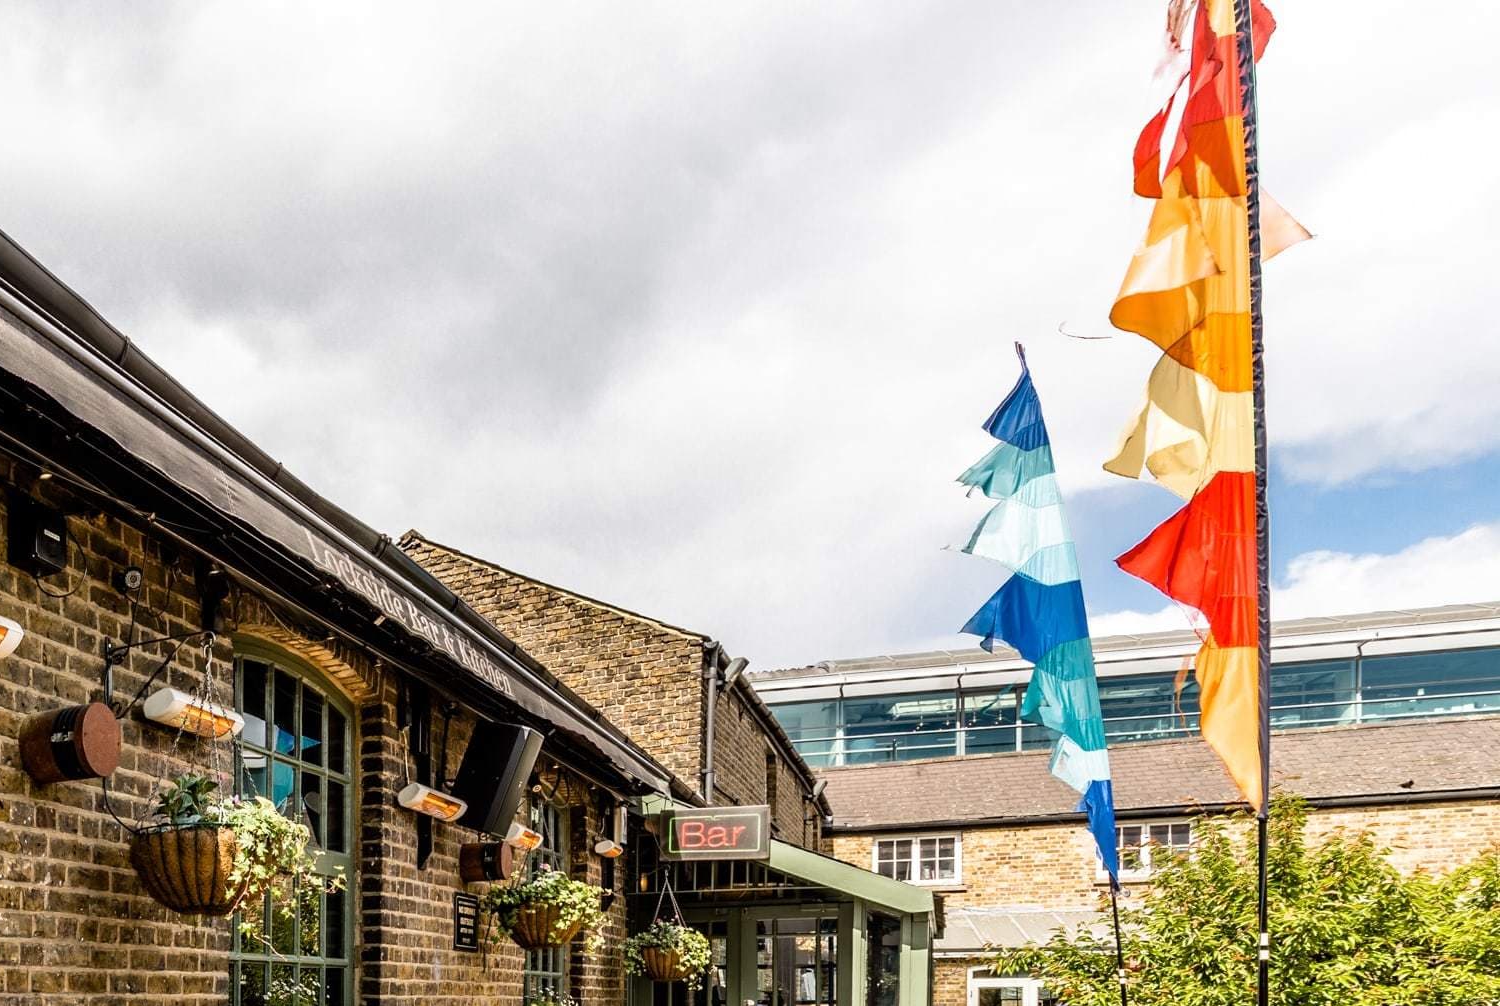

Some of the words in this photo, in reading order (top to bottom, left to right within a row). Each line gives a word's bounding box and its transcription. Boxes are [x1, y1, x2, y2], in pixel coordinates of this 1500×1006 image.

[302, 525, 406, 623] Lockside
[402, 596, 441, 646] Bar
[440, 623, 459, 660] &
[455, 633, 515, 699] Kitchen
[681, 822, 746, 848] Bar
